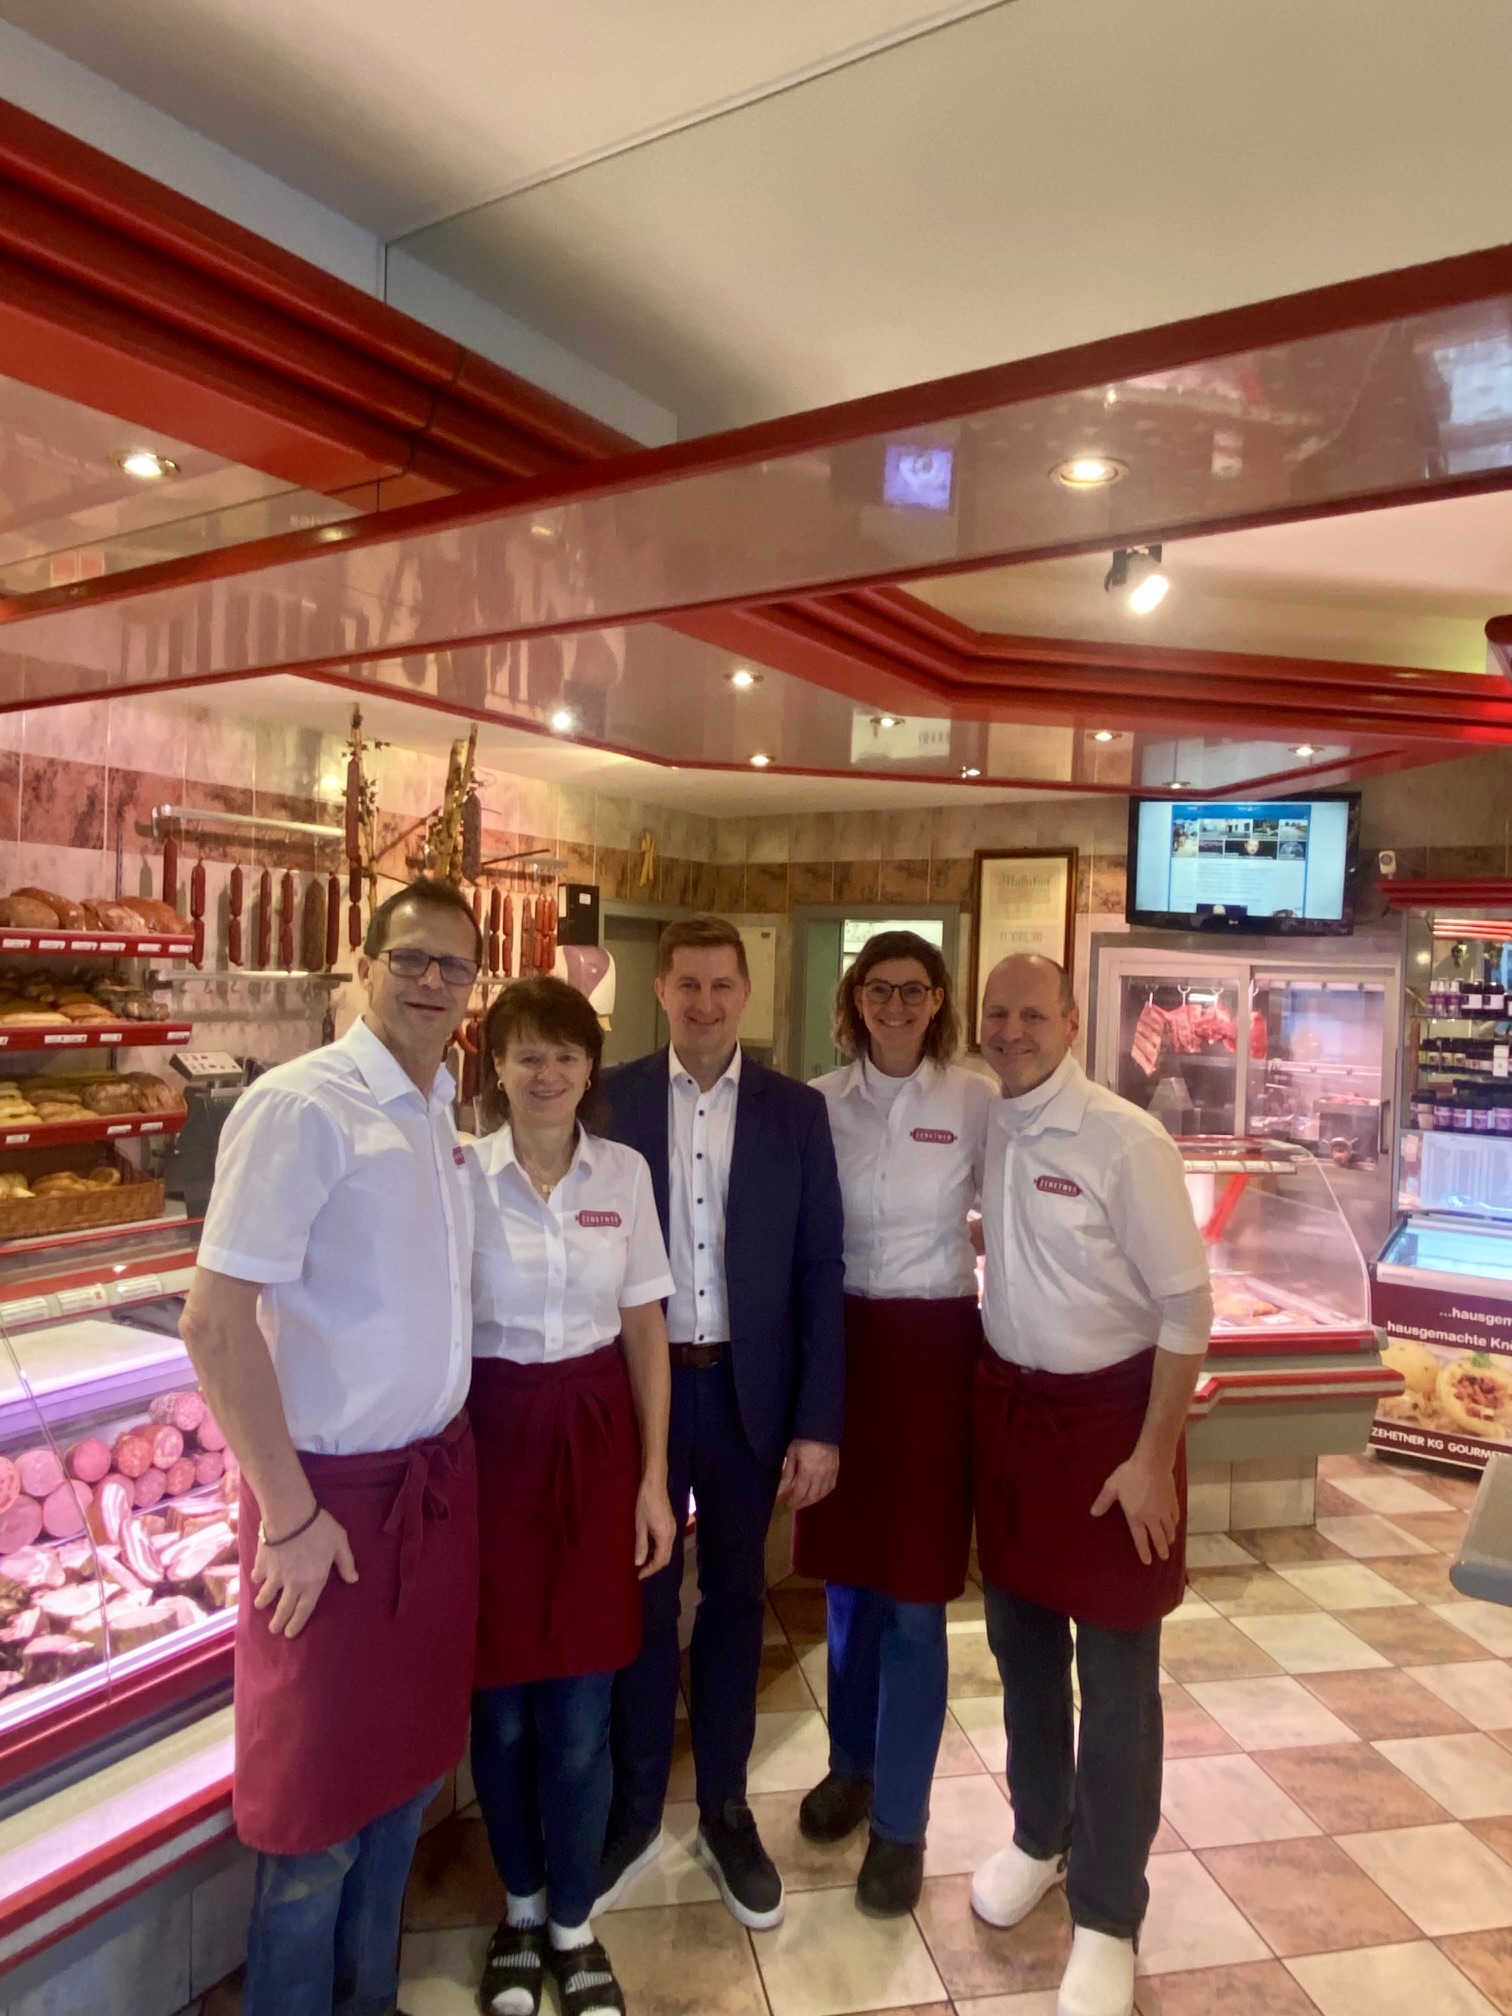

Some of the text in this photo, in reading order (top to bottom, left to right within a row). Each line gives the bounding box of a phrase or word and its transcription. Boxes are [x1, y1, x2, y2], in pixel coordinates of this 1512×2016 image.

[1387, 1320, 1487, 1346] hausgemachte
[1371, 1427, 1425, 1447] ZEHETNER
[1427, 1438, 1444, 1450] KG
